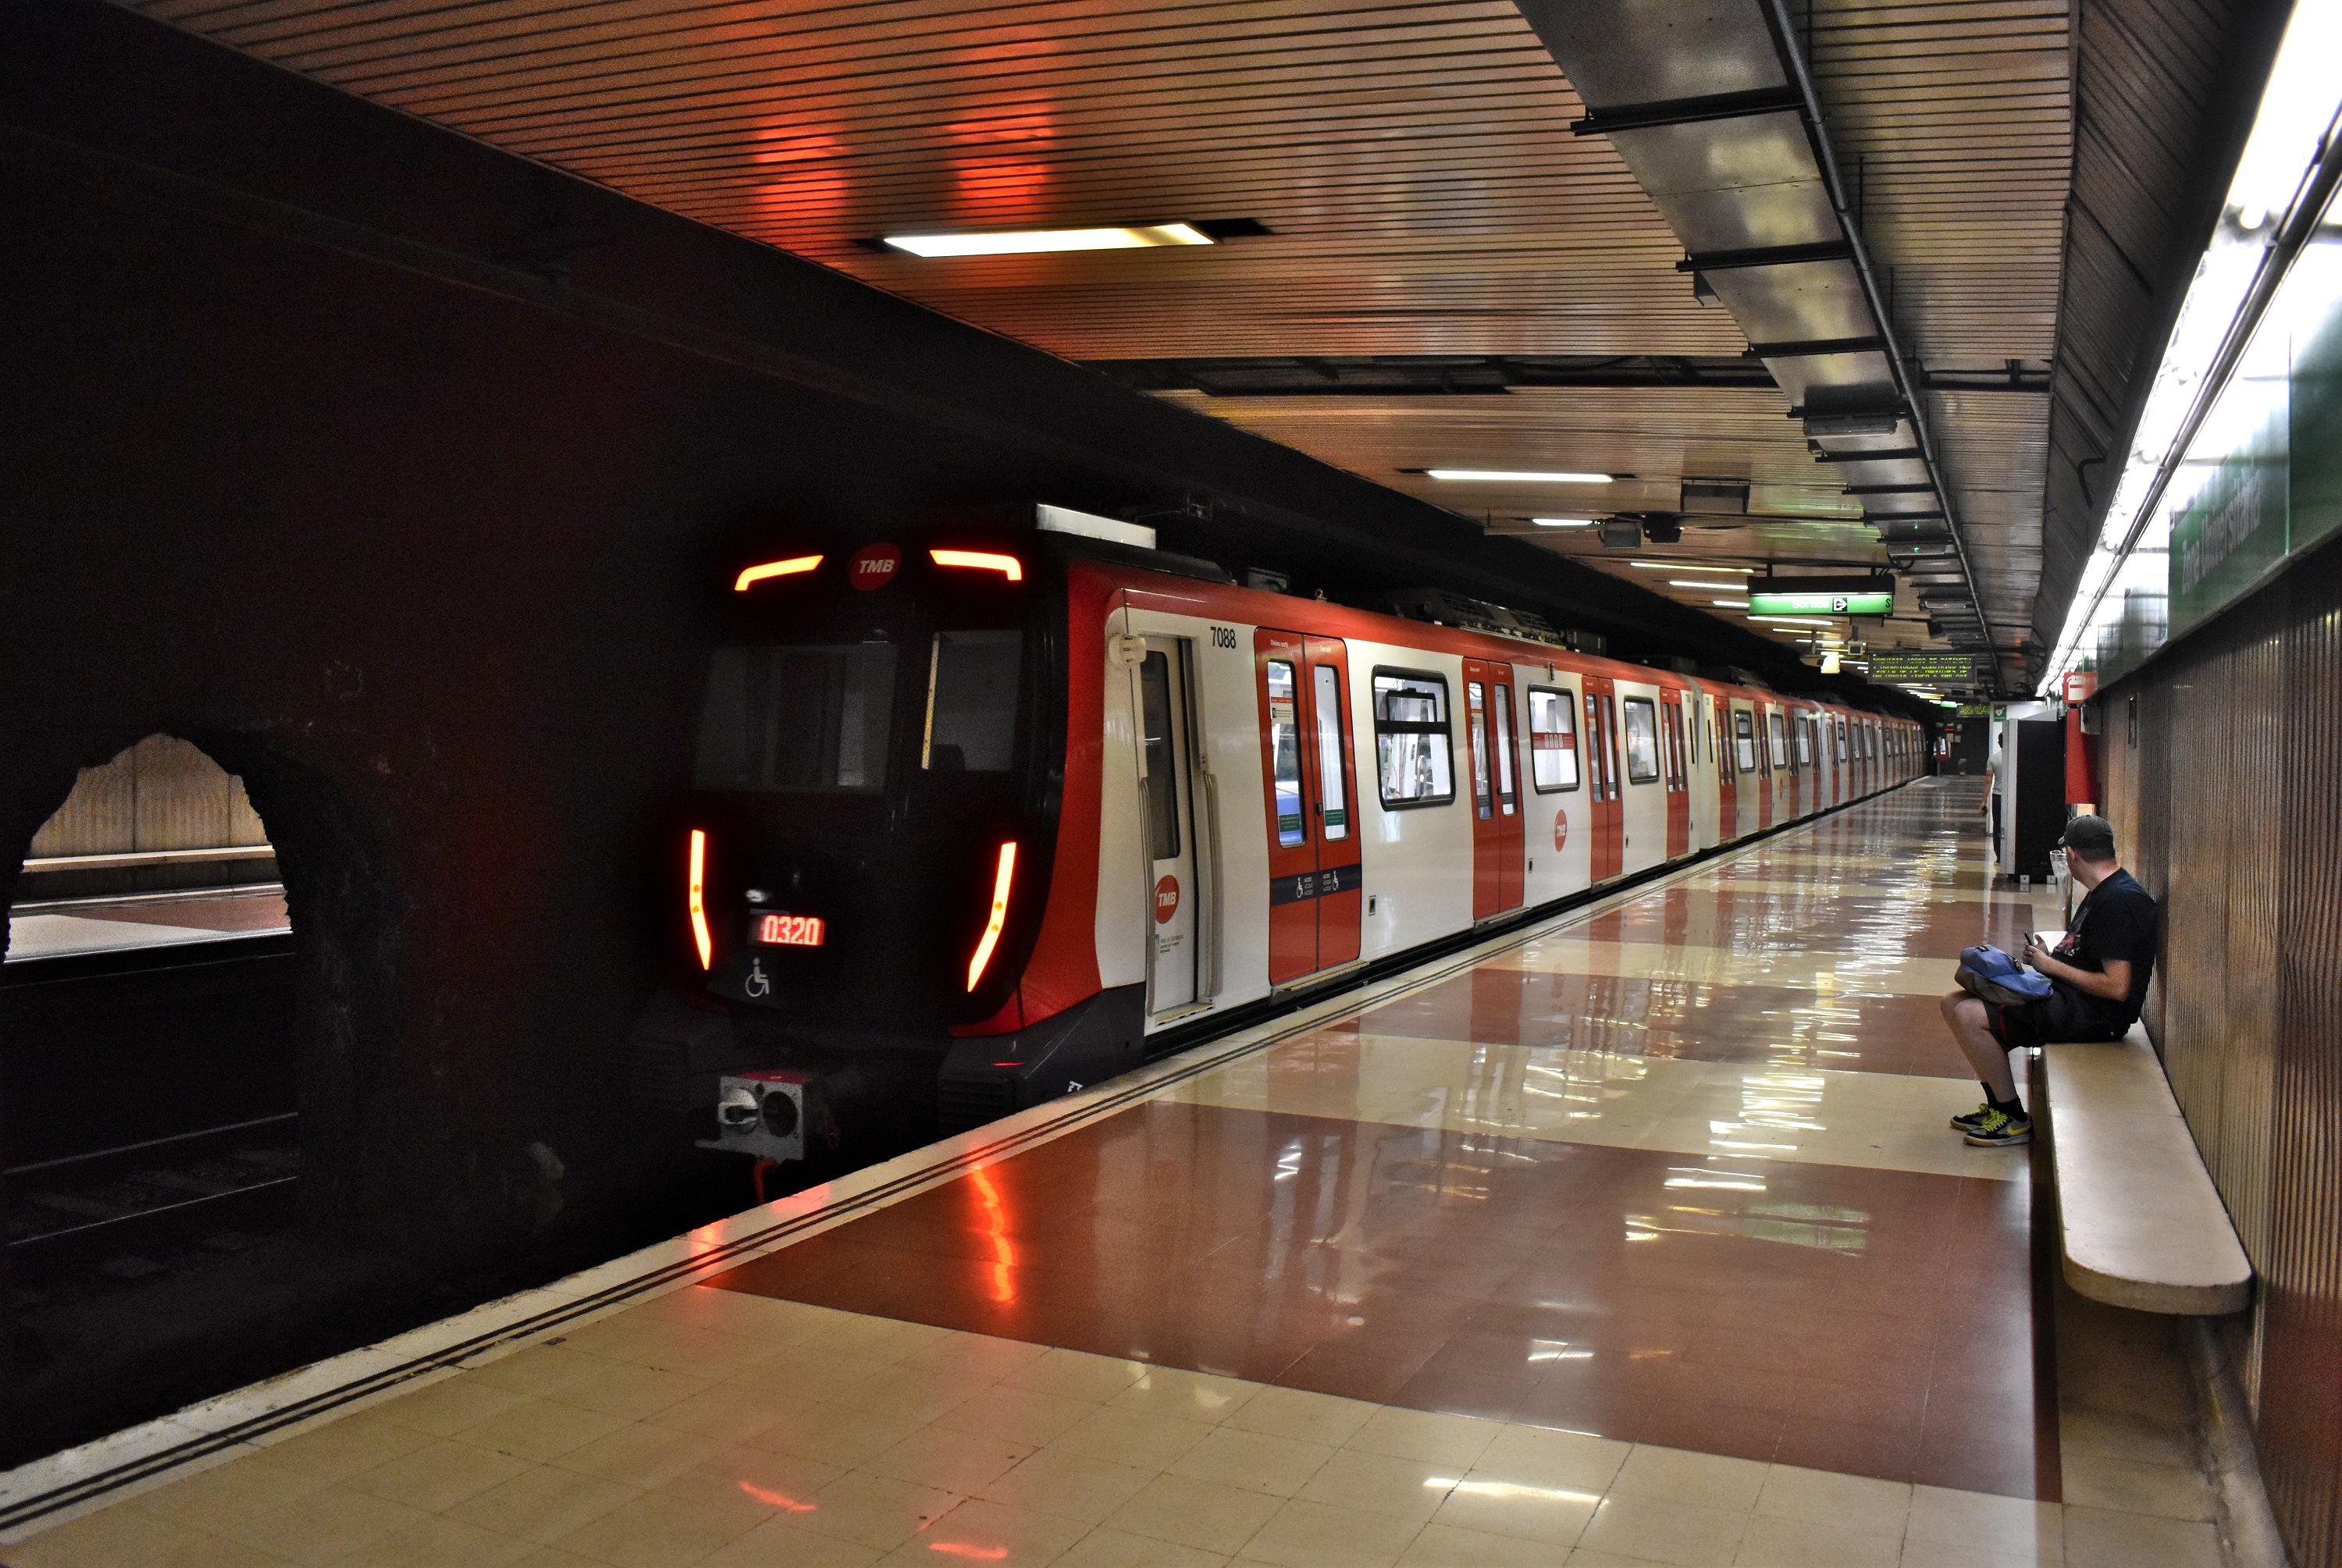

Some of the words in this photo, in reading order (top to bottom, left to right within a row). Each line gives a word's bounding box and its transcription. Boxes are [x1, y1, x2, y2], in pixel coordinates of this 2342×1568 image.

[860, 559, 895, 574] TMB
[2181, 538, 2201, 596] Zona
[1210, 626, 1237, 649] 7088
[1159, 891, 1177, 907] TMB
[763, 915, 820, 945] 0320
